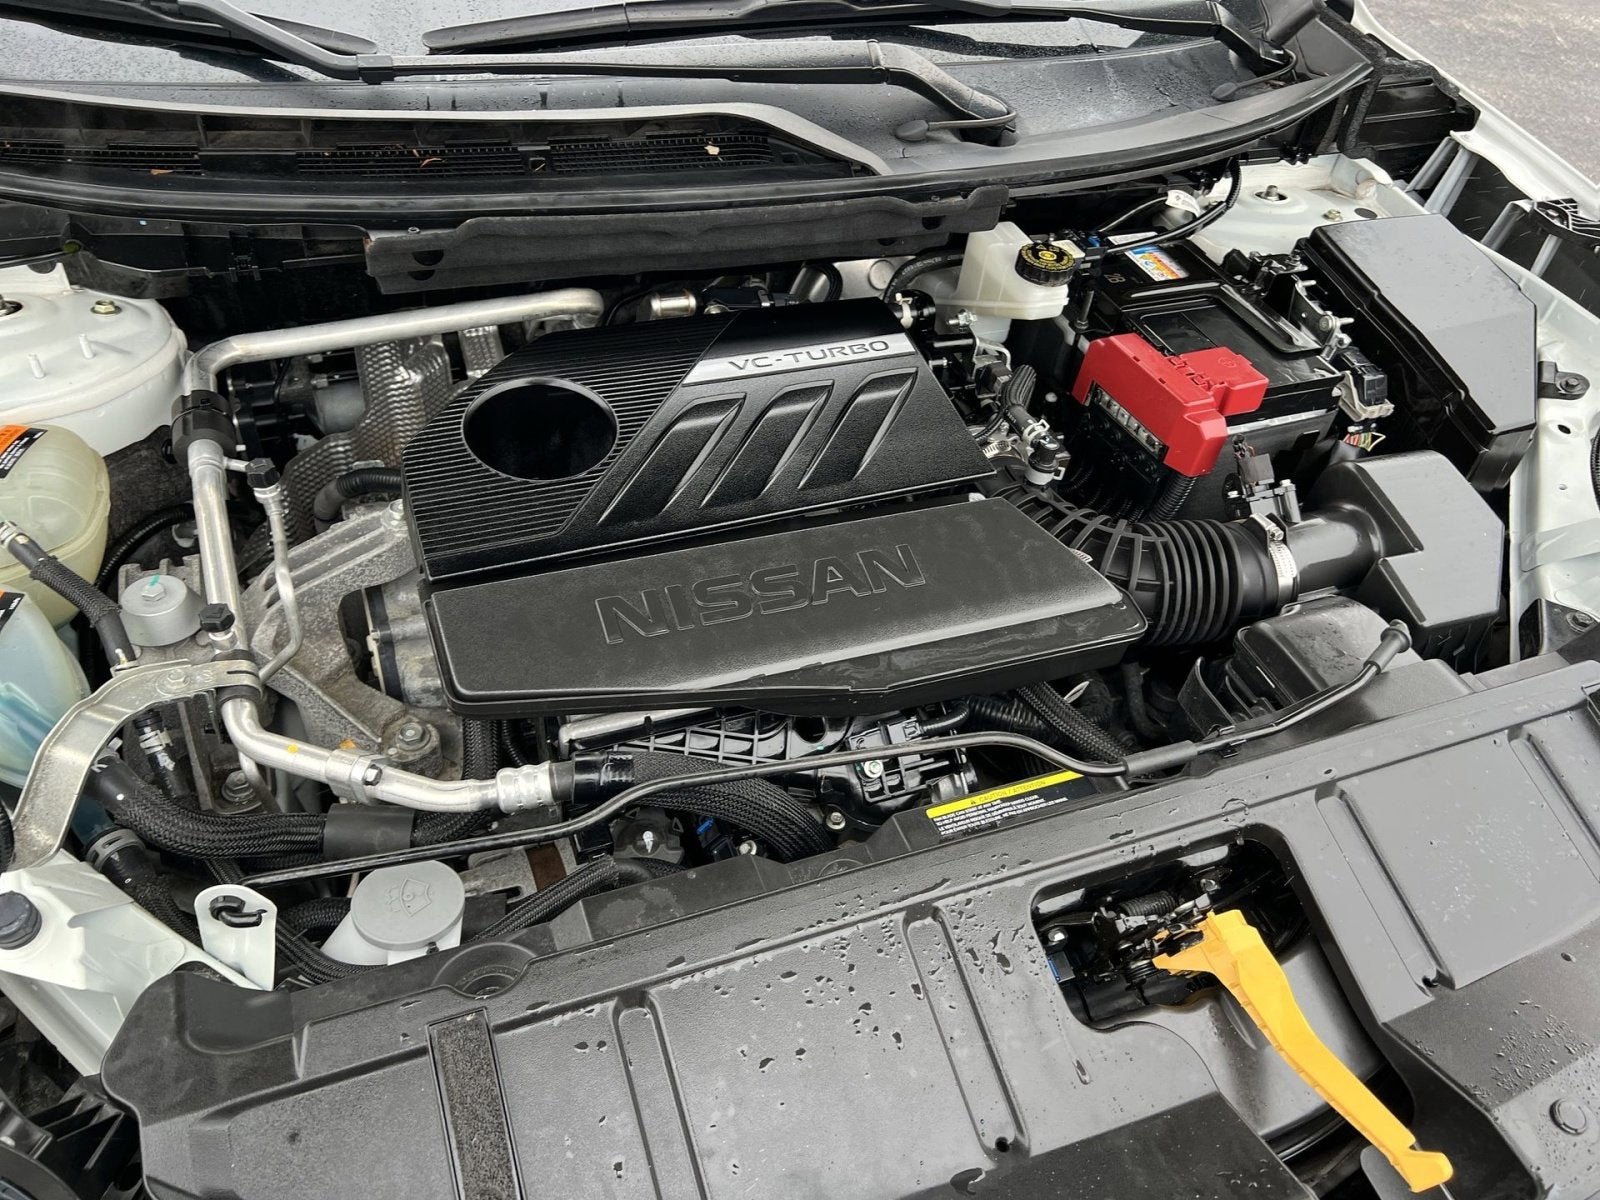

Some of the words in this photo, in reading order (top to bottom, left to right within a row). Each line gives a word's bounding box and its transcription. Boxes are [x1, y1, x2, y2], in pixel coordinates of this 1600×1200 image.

[728, 340, 890, 371] VC-TURBO
[595, 543, 926, 644] NISSAN
[979, 789, 1007, 803] CAUTION
[1012, 781, 1046, 794] ATTENTION
